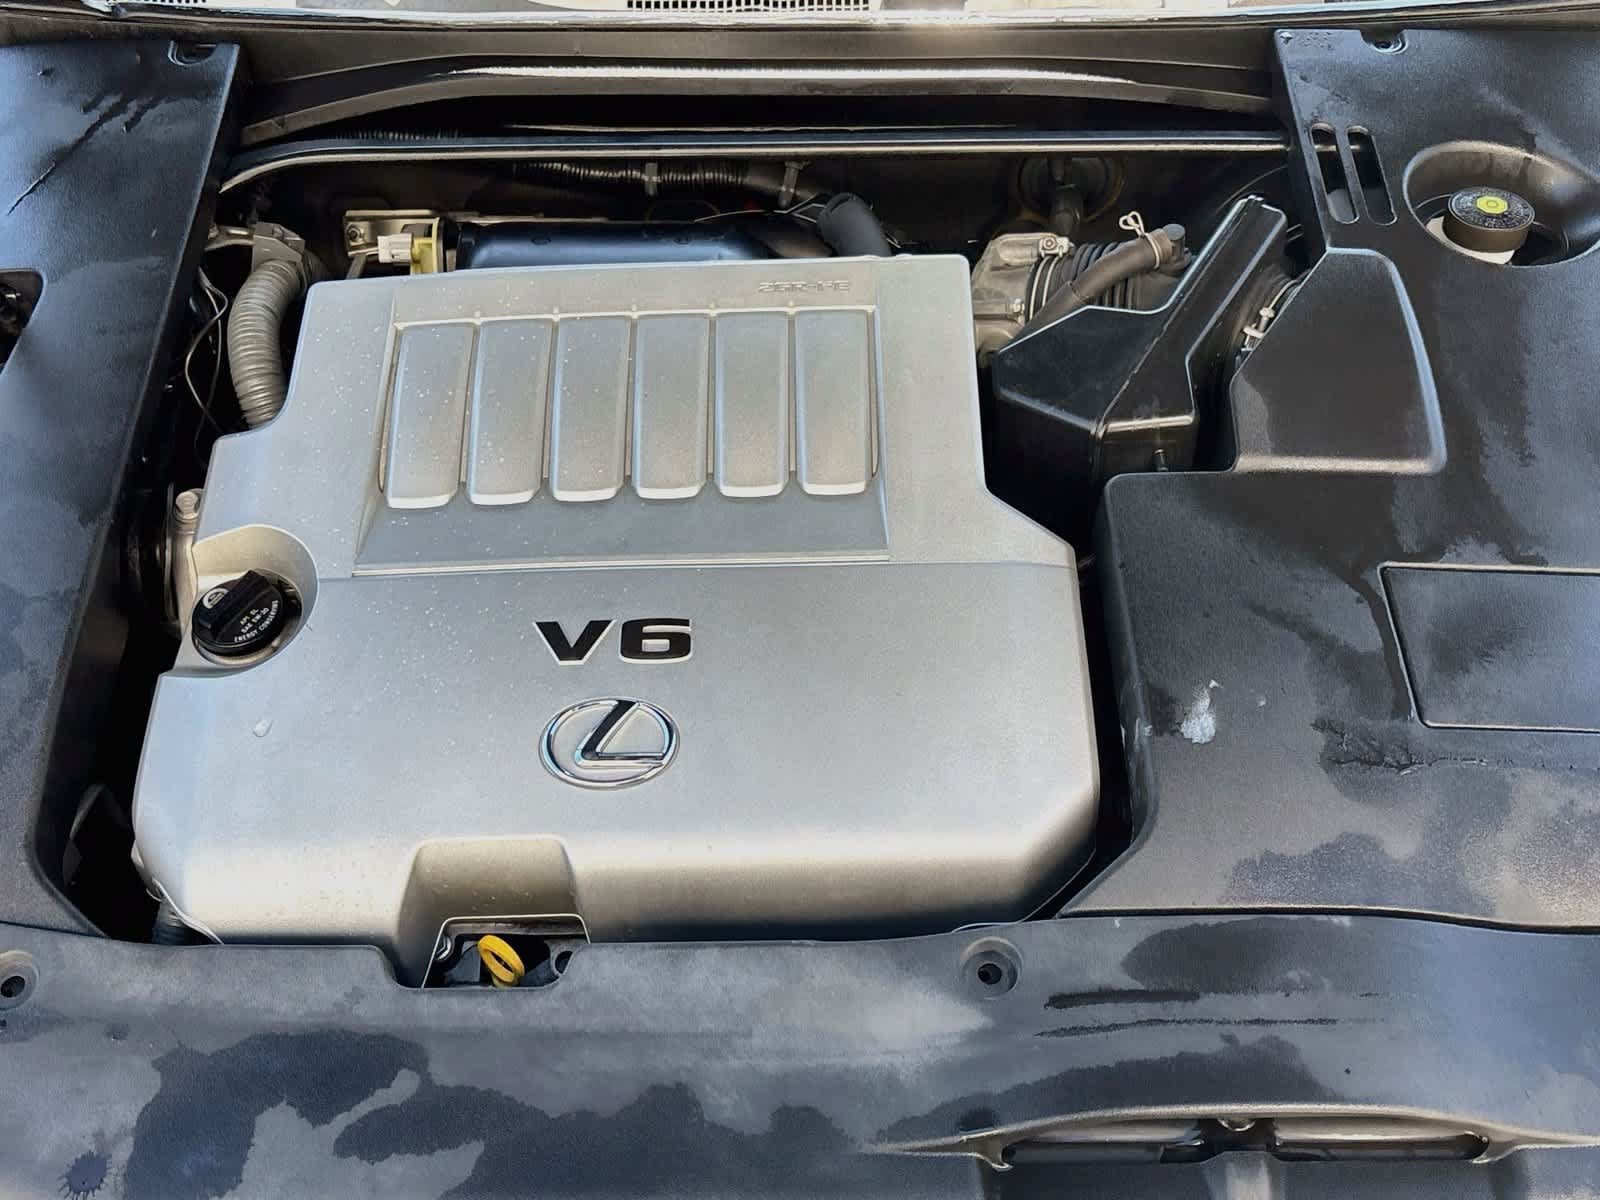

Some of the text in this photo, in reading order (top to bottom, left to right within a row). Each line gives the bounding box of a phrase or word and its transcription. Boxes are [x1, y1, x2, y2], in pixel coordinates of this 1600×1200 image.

[234, 600, 279, 643] ENERGY CONSERVING
[532, 618, 692, 665] V6
